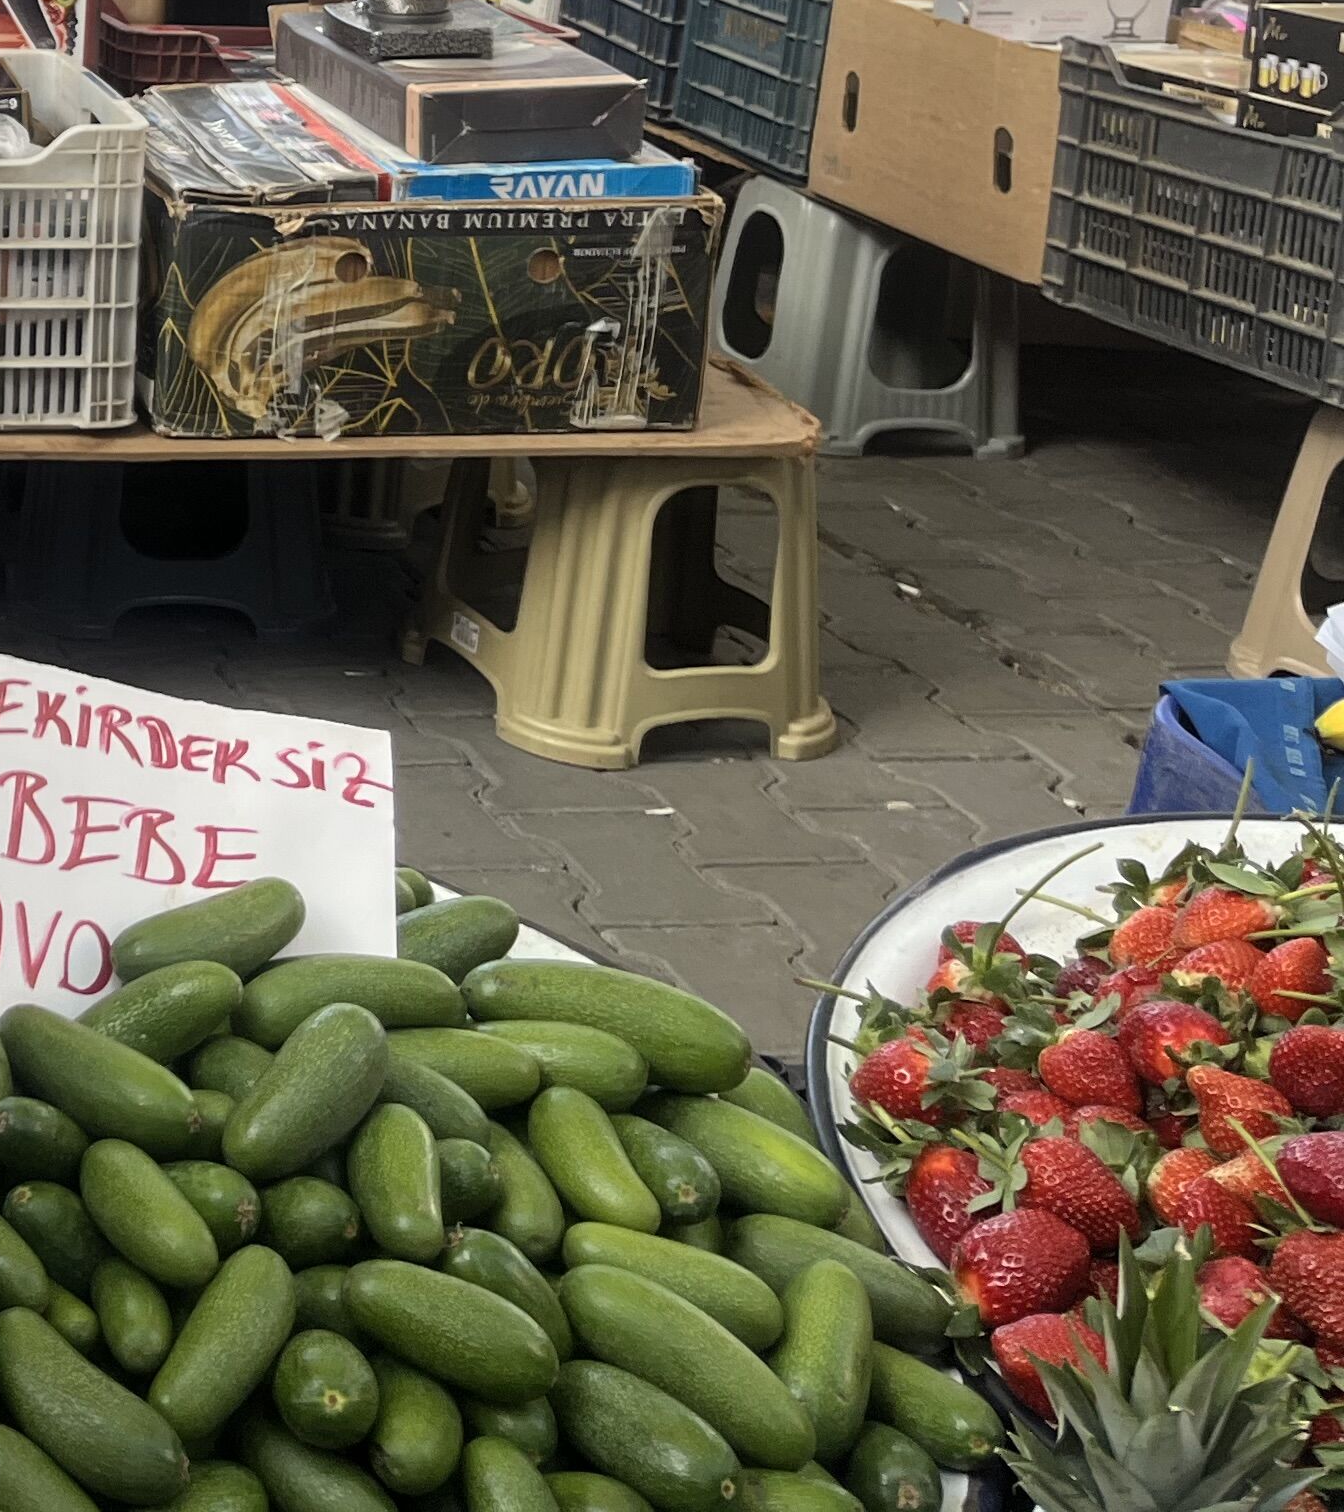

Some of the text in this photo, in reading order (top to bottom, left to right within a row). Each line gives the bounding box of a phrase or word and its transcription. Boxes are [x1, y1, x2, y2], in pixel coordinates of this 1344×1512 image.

[489, 172, 606, 199] RAYAN
[329, 212, 450, 231] BANANAS
[465, 210, 590, 229] PREMIUM
